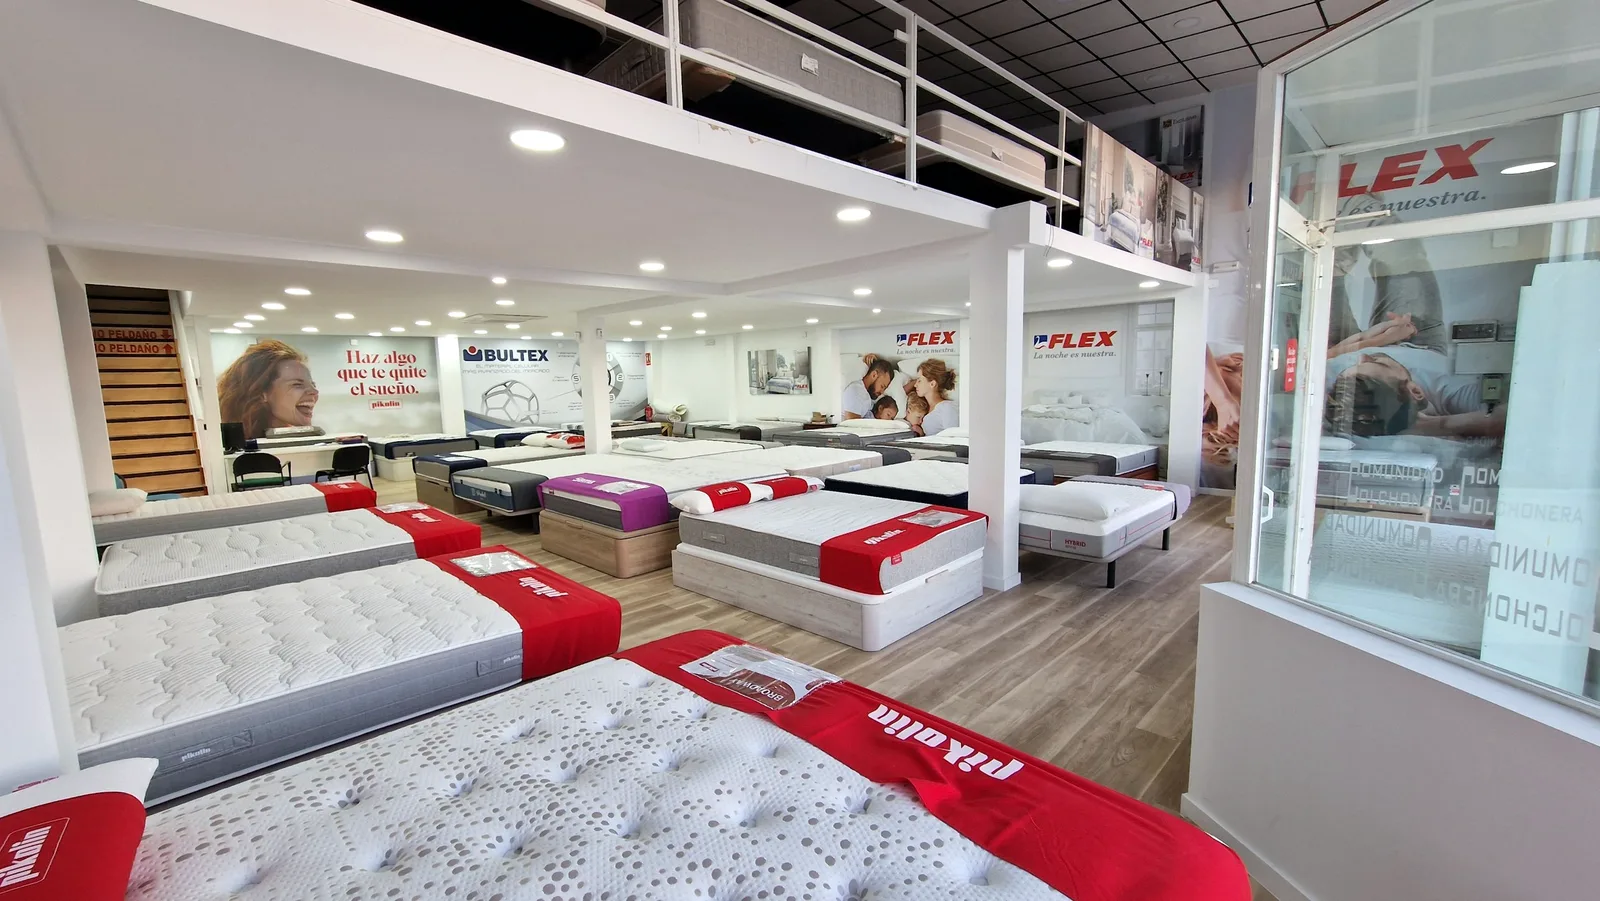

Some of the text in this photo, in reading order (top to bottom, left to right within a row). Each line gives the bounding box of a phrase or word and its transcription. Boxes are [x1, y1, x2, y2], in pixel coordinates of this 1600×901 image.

[108, 329, 157, 339] PELDAÑO
[907, 330, 956, 346] FLEX
[1048, 330, 1117, 349] FLEX
[109, 343, 159, 353] PELDAÑO
[1045, 351, 1069, 359] noche
[1081, 350, 1117, 358] nuestra.
[346, 350, 417, 366] Haz algo
[484, 349, 549, 362] BULTEX
[337, 365, 427, 382] que te quite
[350, 381, 419, 396] el sueño.
[371, 401, 400, 409] pikolin
[1064, 539, 1086, 548] HYBRID
[867, 704, 1025, 781] pikolin
